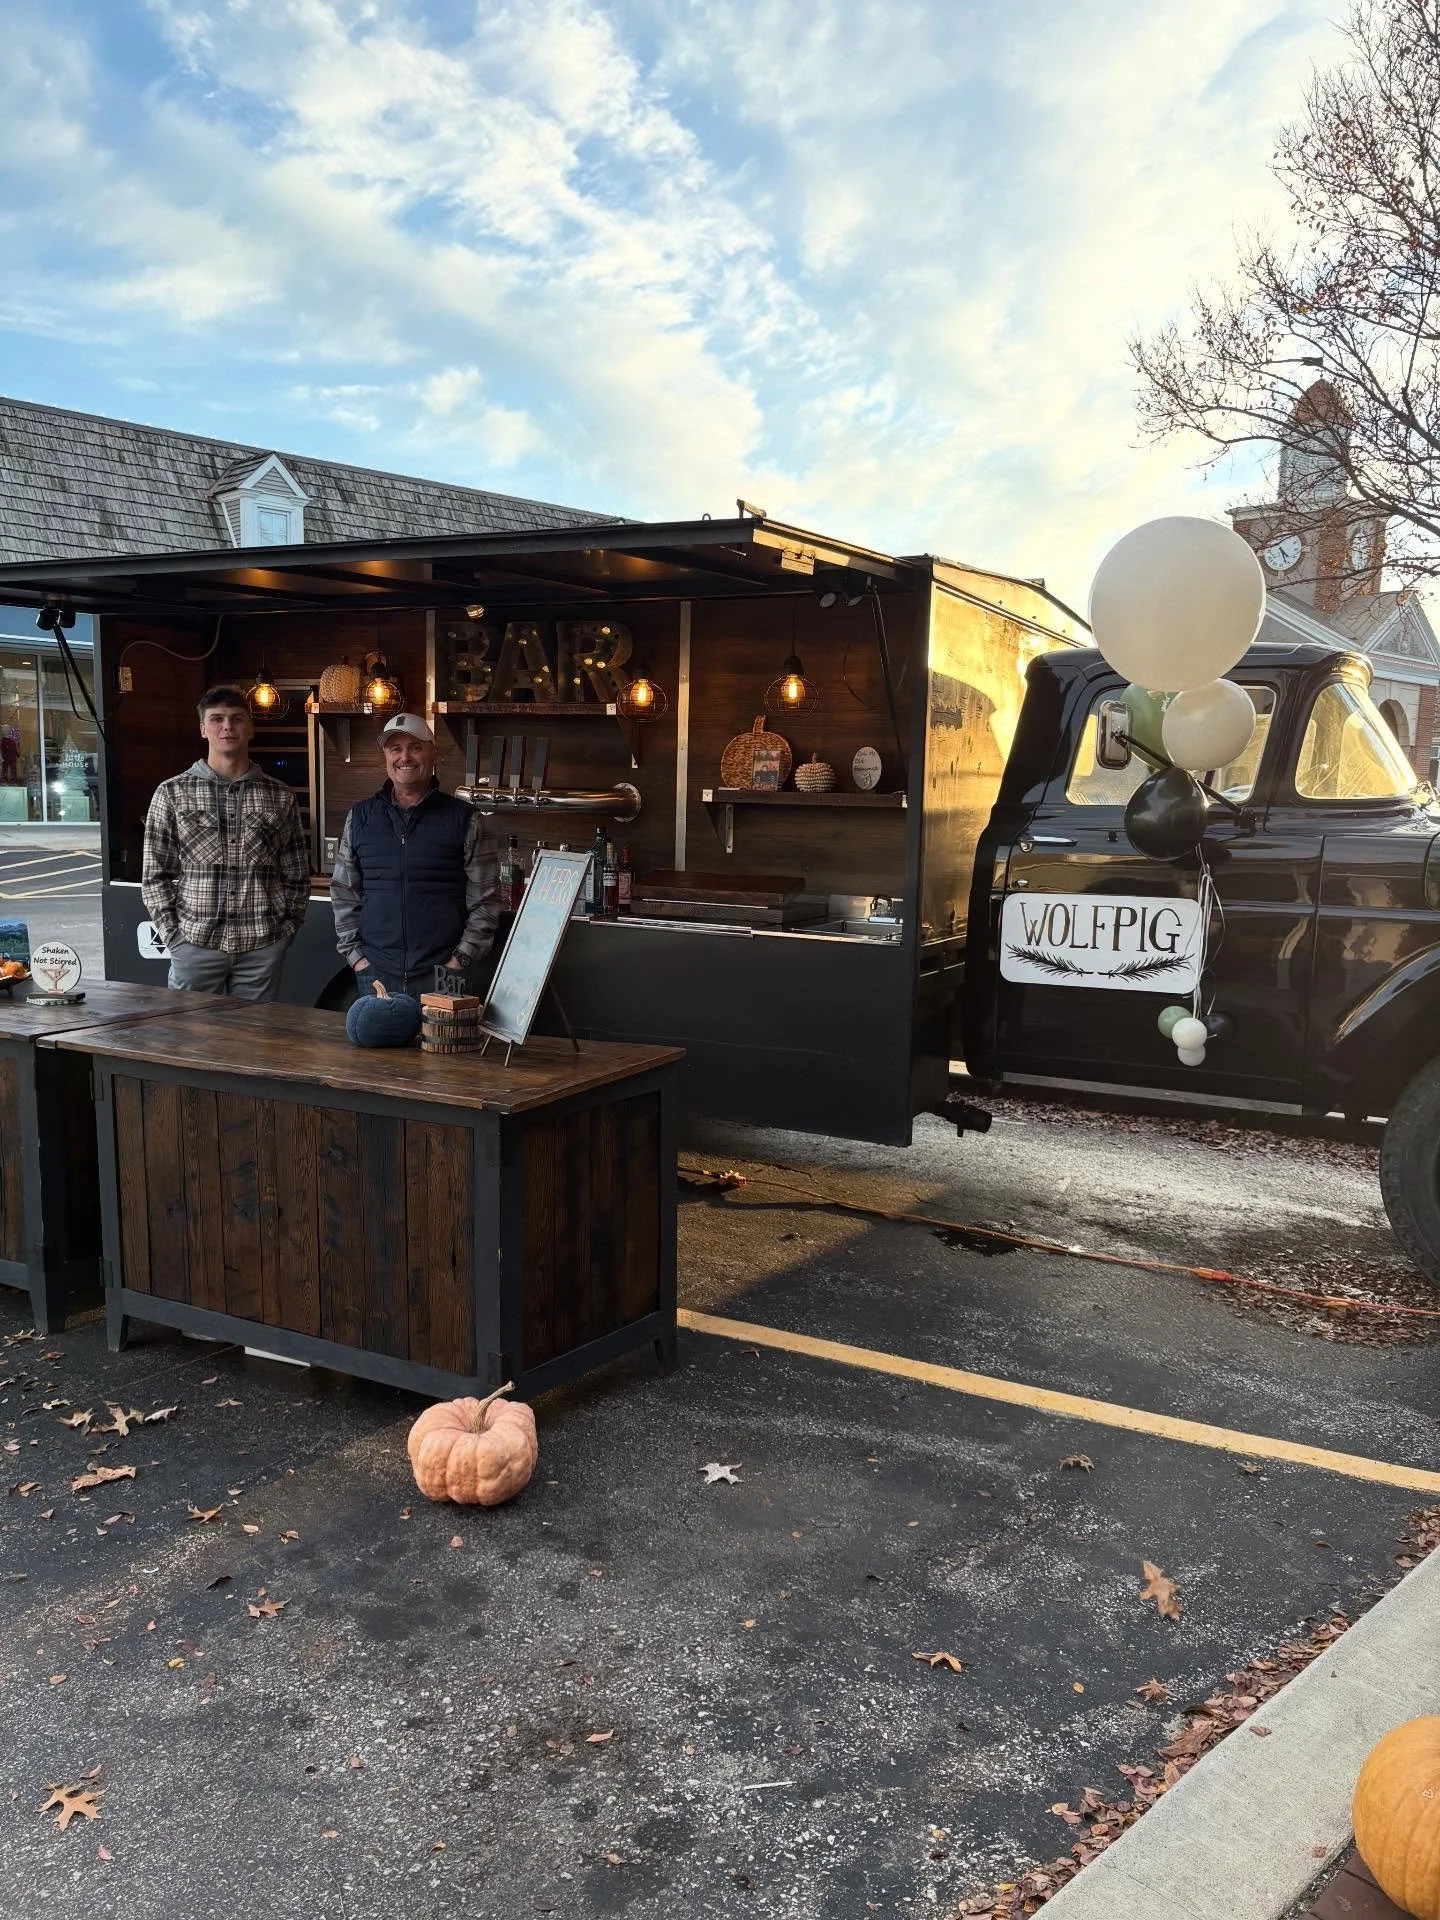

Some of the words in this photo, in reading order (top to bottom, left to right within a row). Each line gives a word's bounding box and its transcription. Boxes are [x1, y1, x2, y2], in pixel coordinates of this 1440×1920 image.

[440, 620, 633, 702] BAR
[1019, 901, 1182, 954] WOLFPIG
[33, 957, 48, 965] Not
[49, 957, 78, 966] Stirred
[41, 946, 70, 955] Shaken
[433, 964, 466, 997] Bar
